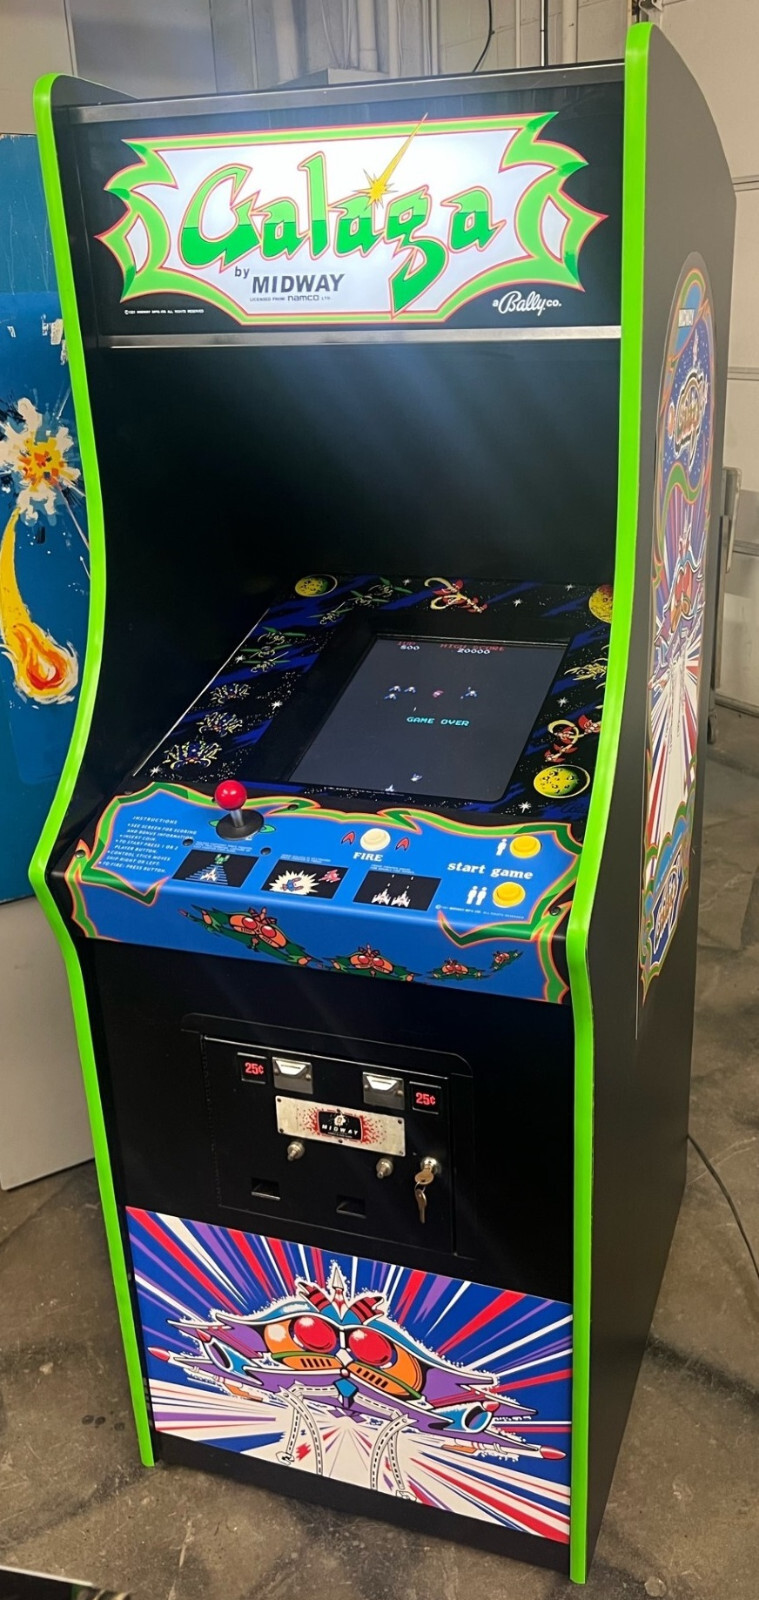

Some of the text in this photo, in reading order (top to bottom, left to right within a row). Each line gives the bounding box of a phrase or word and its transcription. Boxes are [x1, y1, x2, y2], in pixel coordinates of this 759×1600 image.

[180, 151, 506, 320] Galaga
[235, 266, 250, 279] by
[252, 273, 345, 294] MIDWAY
[406, 716, 470, 727] GAME OVER
[132, 816, 178, 824] INSTRUCTIONS
[353, 852, 384, 862] FIRE
[447, 862, 534, 880] start game
[244, 1062, 264, 1075] 25¢
[416, 1092, 436, 1106] 25¢
[322, 1124, 358, 1136] MIDWAY
